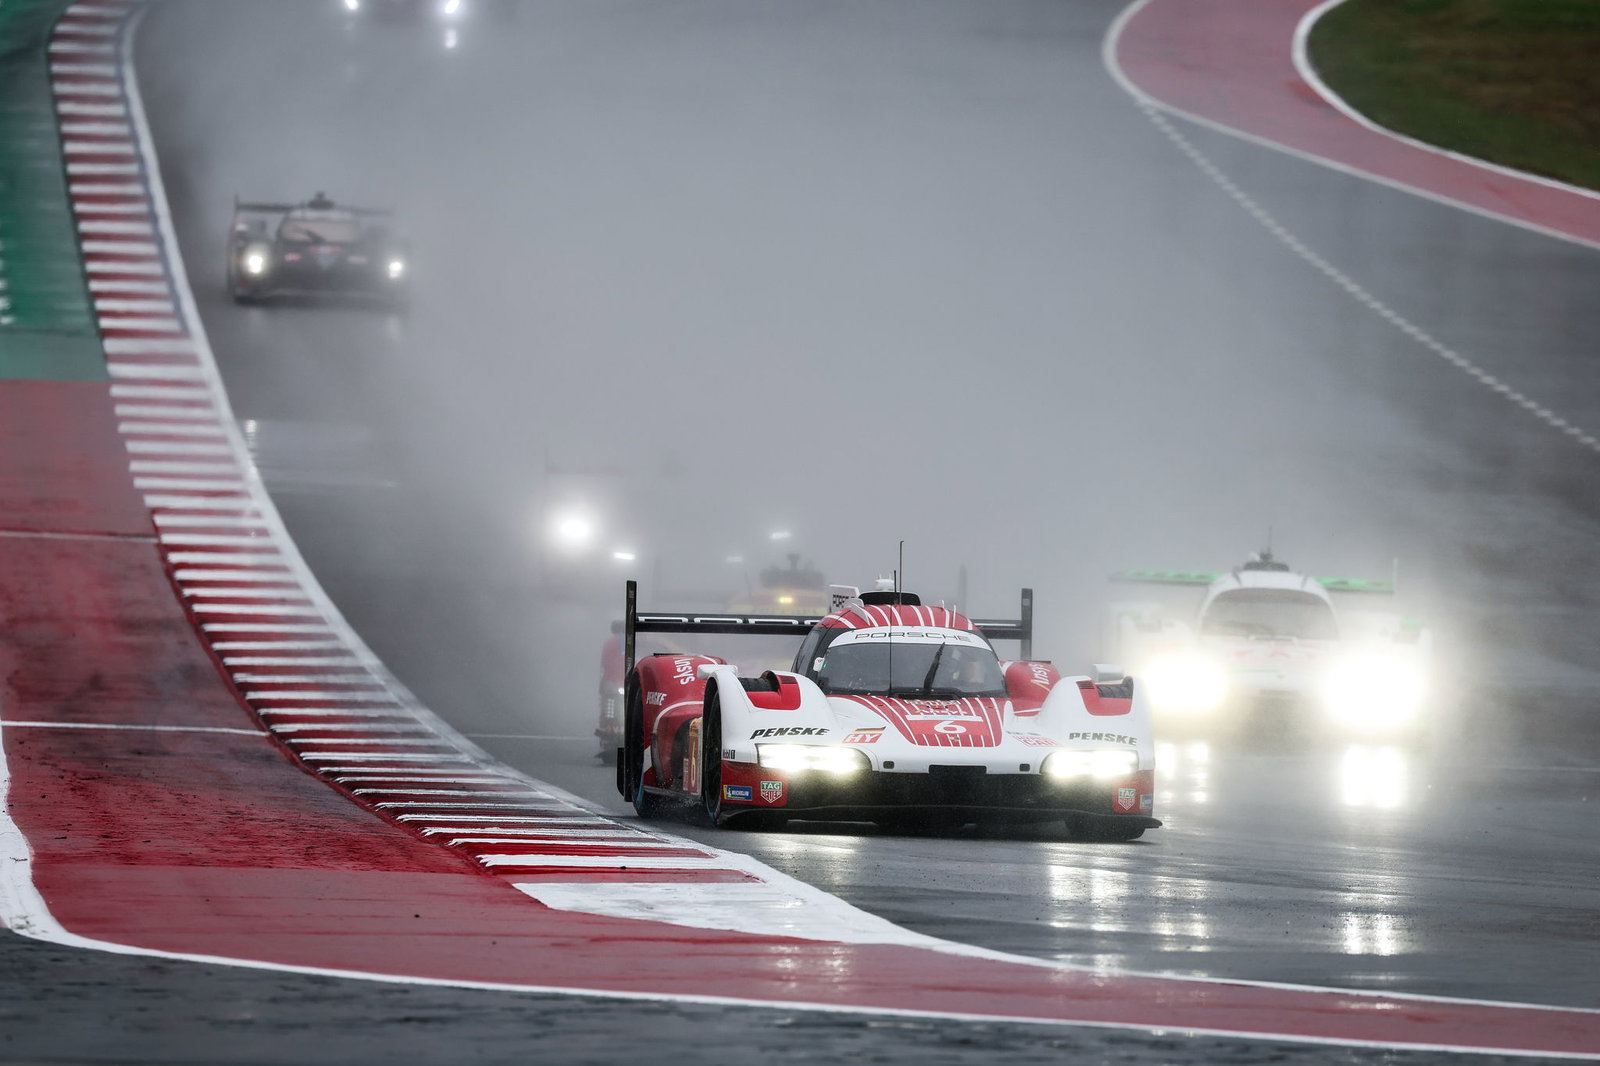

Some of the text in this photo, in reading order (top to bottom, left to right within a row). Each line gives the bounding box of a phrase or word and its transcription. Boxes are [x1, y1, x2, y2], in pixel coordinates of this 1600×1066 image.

[855, 632, 972, 643] PORSCHE
[933, 720, 967, 734] 6
[750, 727, 830, 740] PENSKE
[843, 733, 882, 744] HY
[1069, 732, 1138, 746] PENSKE
[762, 782, 781, 790] TAG
[761, 790, 782, 801] HEUER
